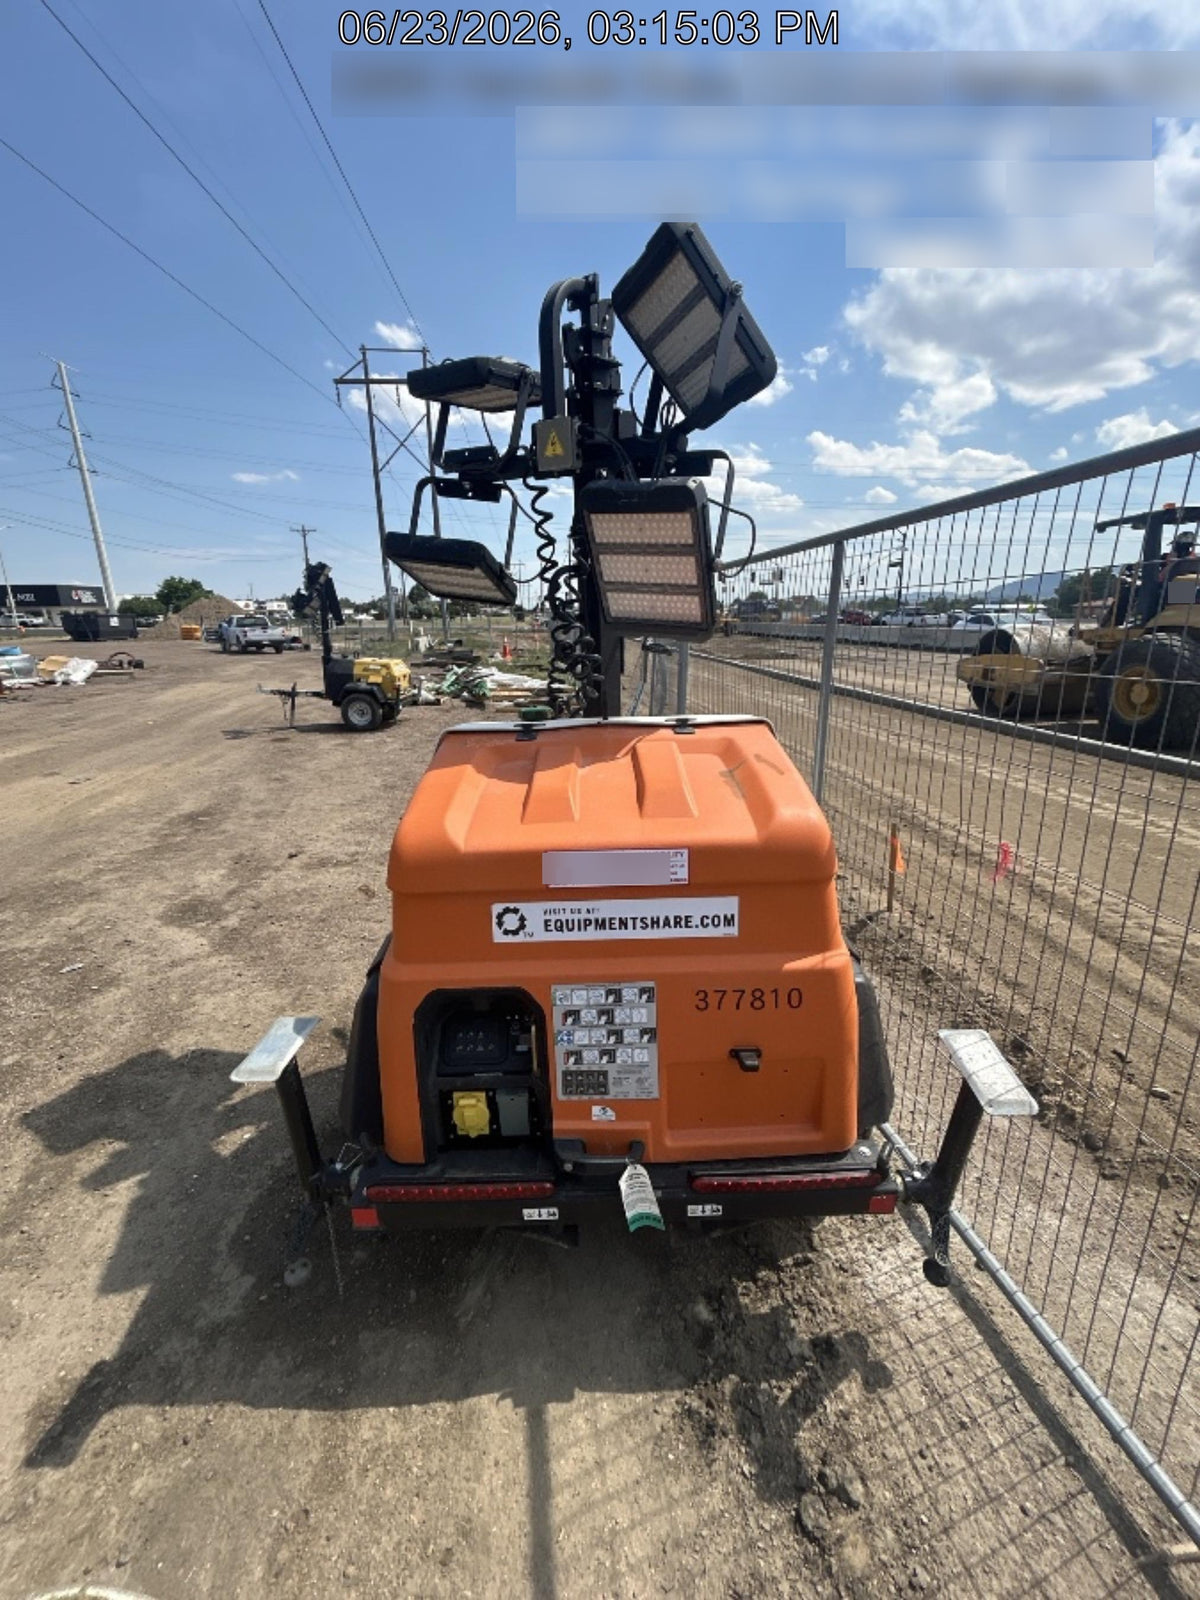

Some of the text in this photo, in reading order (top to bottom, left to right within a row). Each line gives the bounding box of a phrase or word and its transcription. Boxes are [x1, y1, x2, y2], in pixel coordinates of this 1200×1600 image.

[570, 907, 582, 915] US
[543, 914, 735, 933] EQUIPMENTSHARE.COM
[694, 987, 804, 1012] 377810
